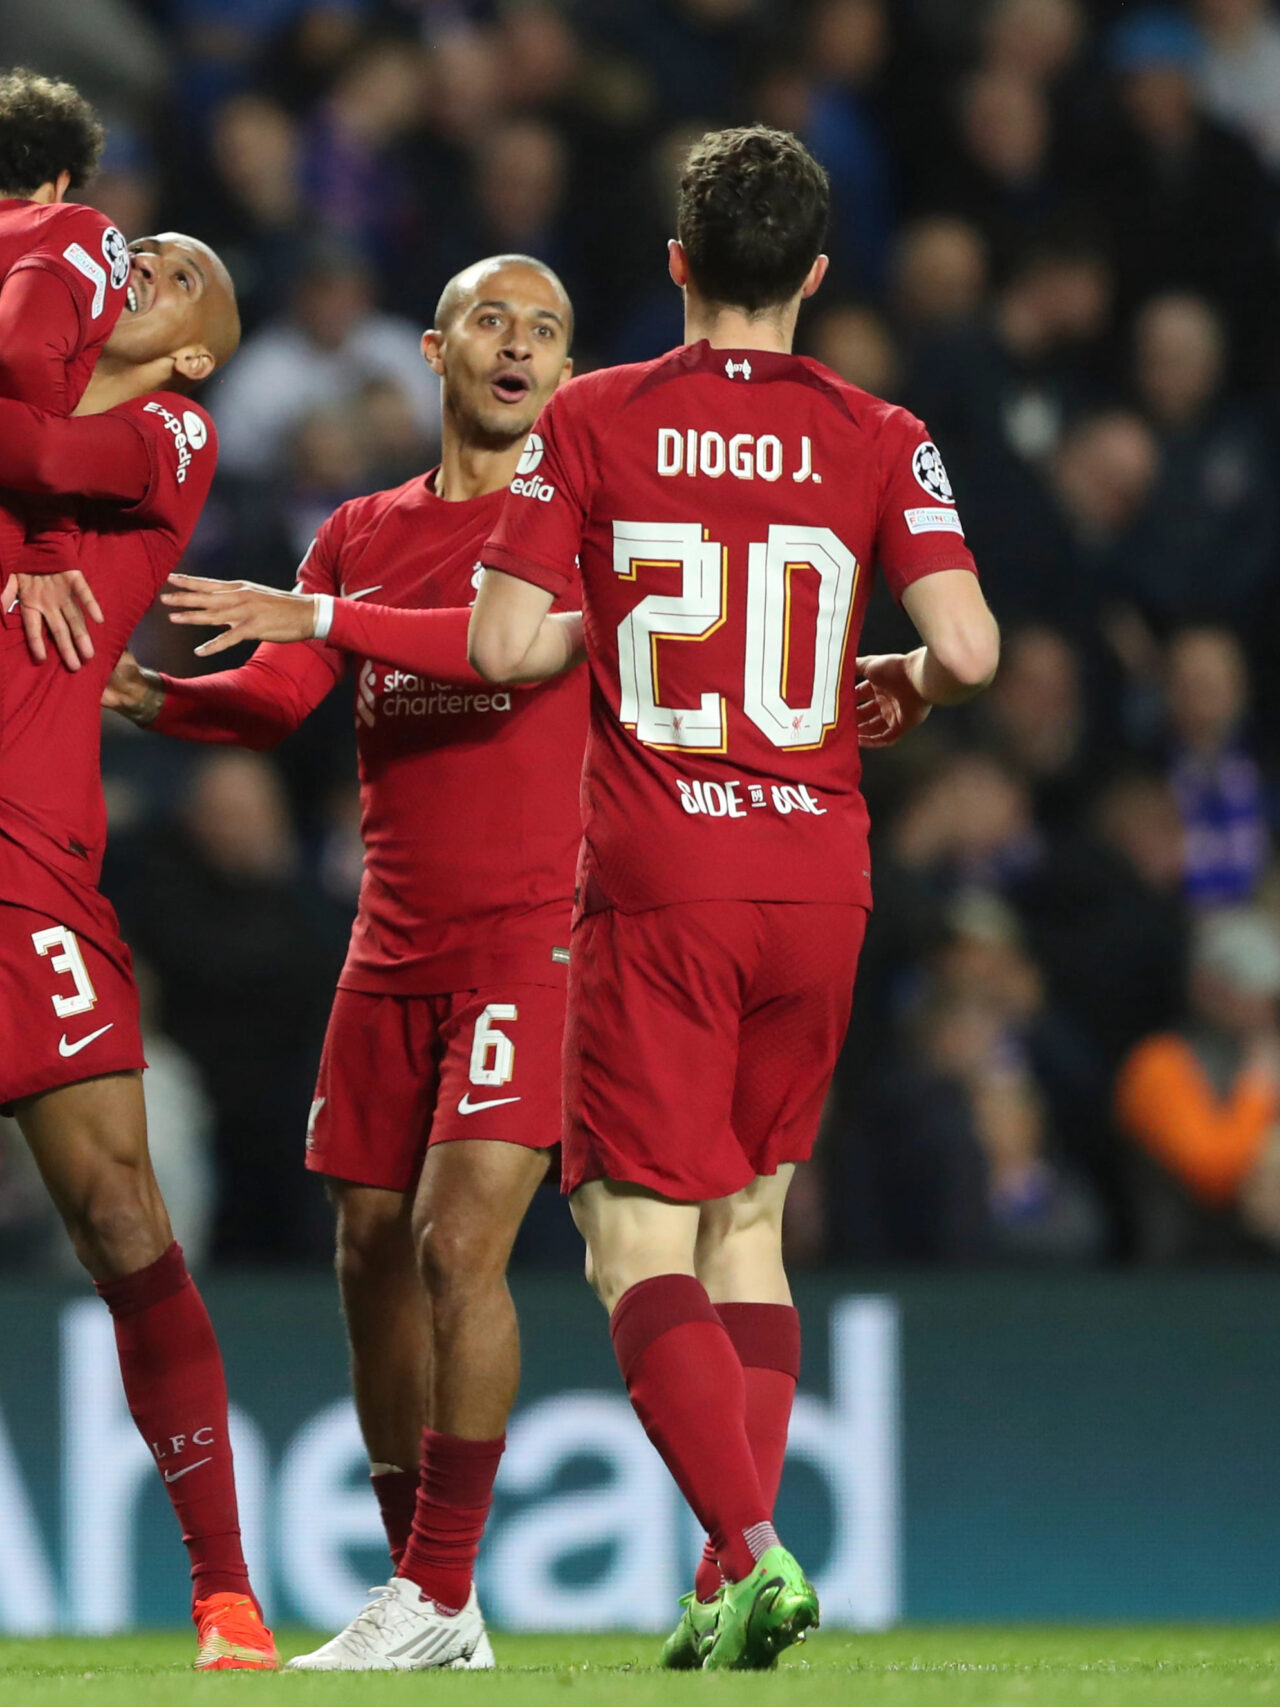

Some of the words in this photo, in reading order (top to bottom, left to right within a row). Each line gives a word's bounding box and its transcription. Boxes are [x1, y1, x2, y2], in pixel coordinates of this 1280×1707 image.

[142, 401, 192, 484] Expedia
[657, 428, 783, 482] DIOGO
[792, 436, 822, 483] J.
[612, 519, 860, 754] 20
[676, 779, 748, 818] SIDE
[31, 924, 98, 1019] 3
[469, 1003, 518, 1087] 6
